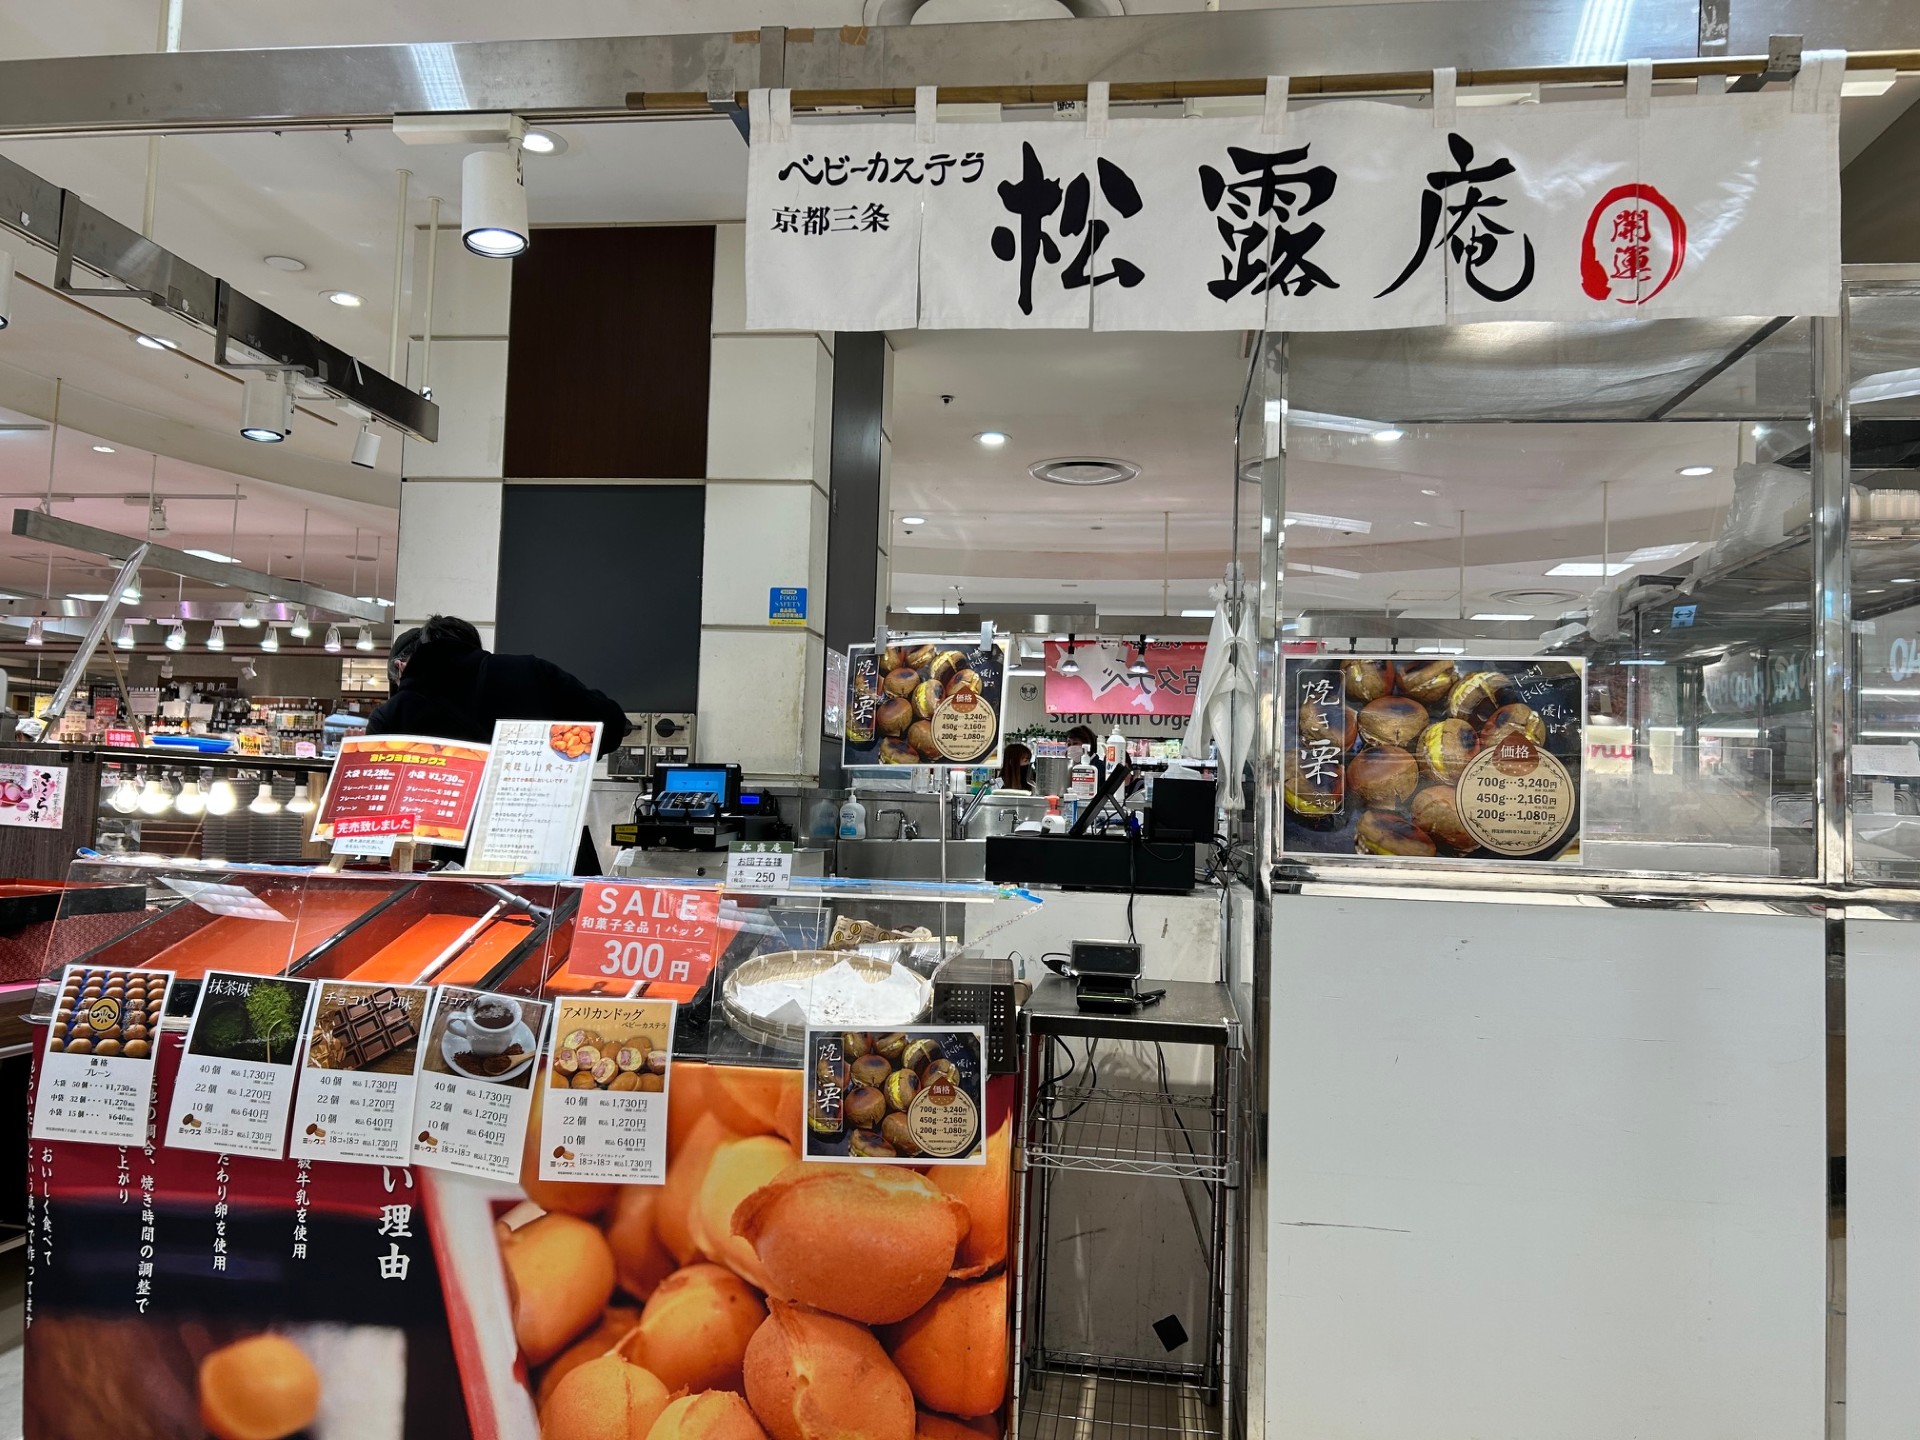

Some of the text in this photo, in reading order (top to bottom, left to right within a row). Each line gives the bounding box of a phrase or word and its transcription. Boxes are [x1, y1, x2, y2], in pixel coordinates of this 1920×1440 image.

[777, 151, 986, 187] ベビーカステラ
[770, 202, 890, 236] 京都三条
[990, 133, 1535, 315] 松露庵
[1610, 209, 1651, 281] 開運
[955, 693, 973, 703] 価格
[1299, 679, 1341, 785] 焼き栗
[1500, 744, 1530, 759] 価格
[336, 818, 411, 834] 完売致しました
[737, 857, 782, 867] お団子各種
[755, 871, 776, 883] 250
[781, 873, 789, 881] 円
[597, 887, 701, 921] SALE
[208, 978, 252, 997] 抹茶味
[324, 991, 414, 1011] チョコレート味
[562, 1006, 645, 1021] アメリカンドッグ
[621, 1022, 667, 1030] ベビーカステラ
[90, 1057, 108, 1067] 価格
[84, 1068, 112, 1077] プレーン
[932, 1084, 950, 1095] 価格
[178, 1127, 202, 1136] ミックス
[302, 1137, 326, 1145] ミックス
[414, 1144, 438, 1154] ミックス
[377, 1165, 414, 1281] い理由
